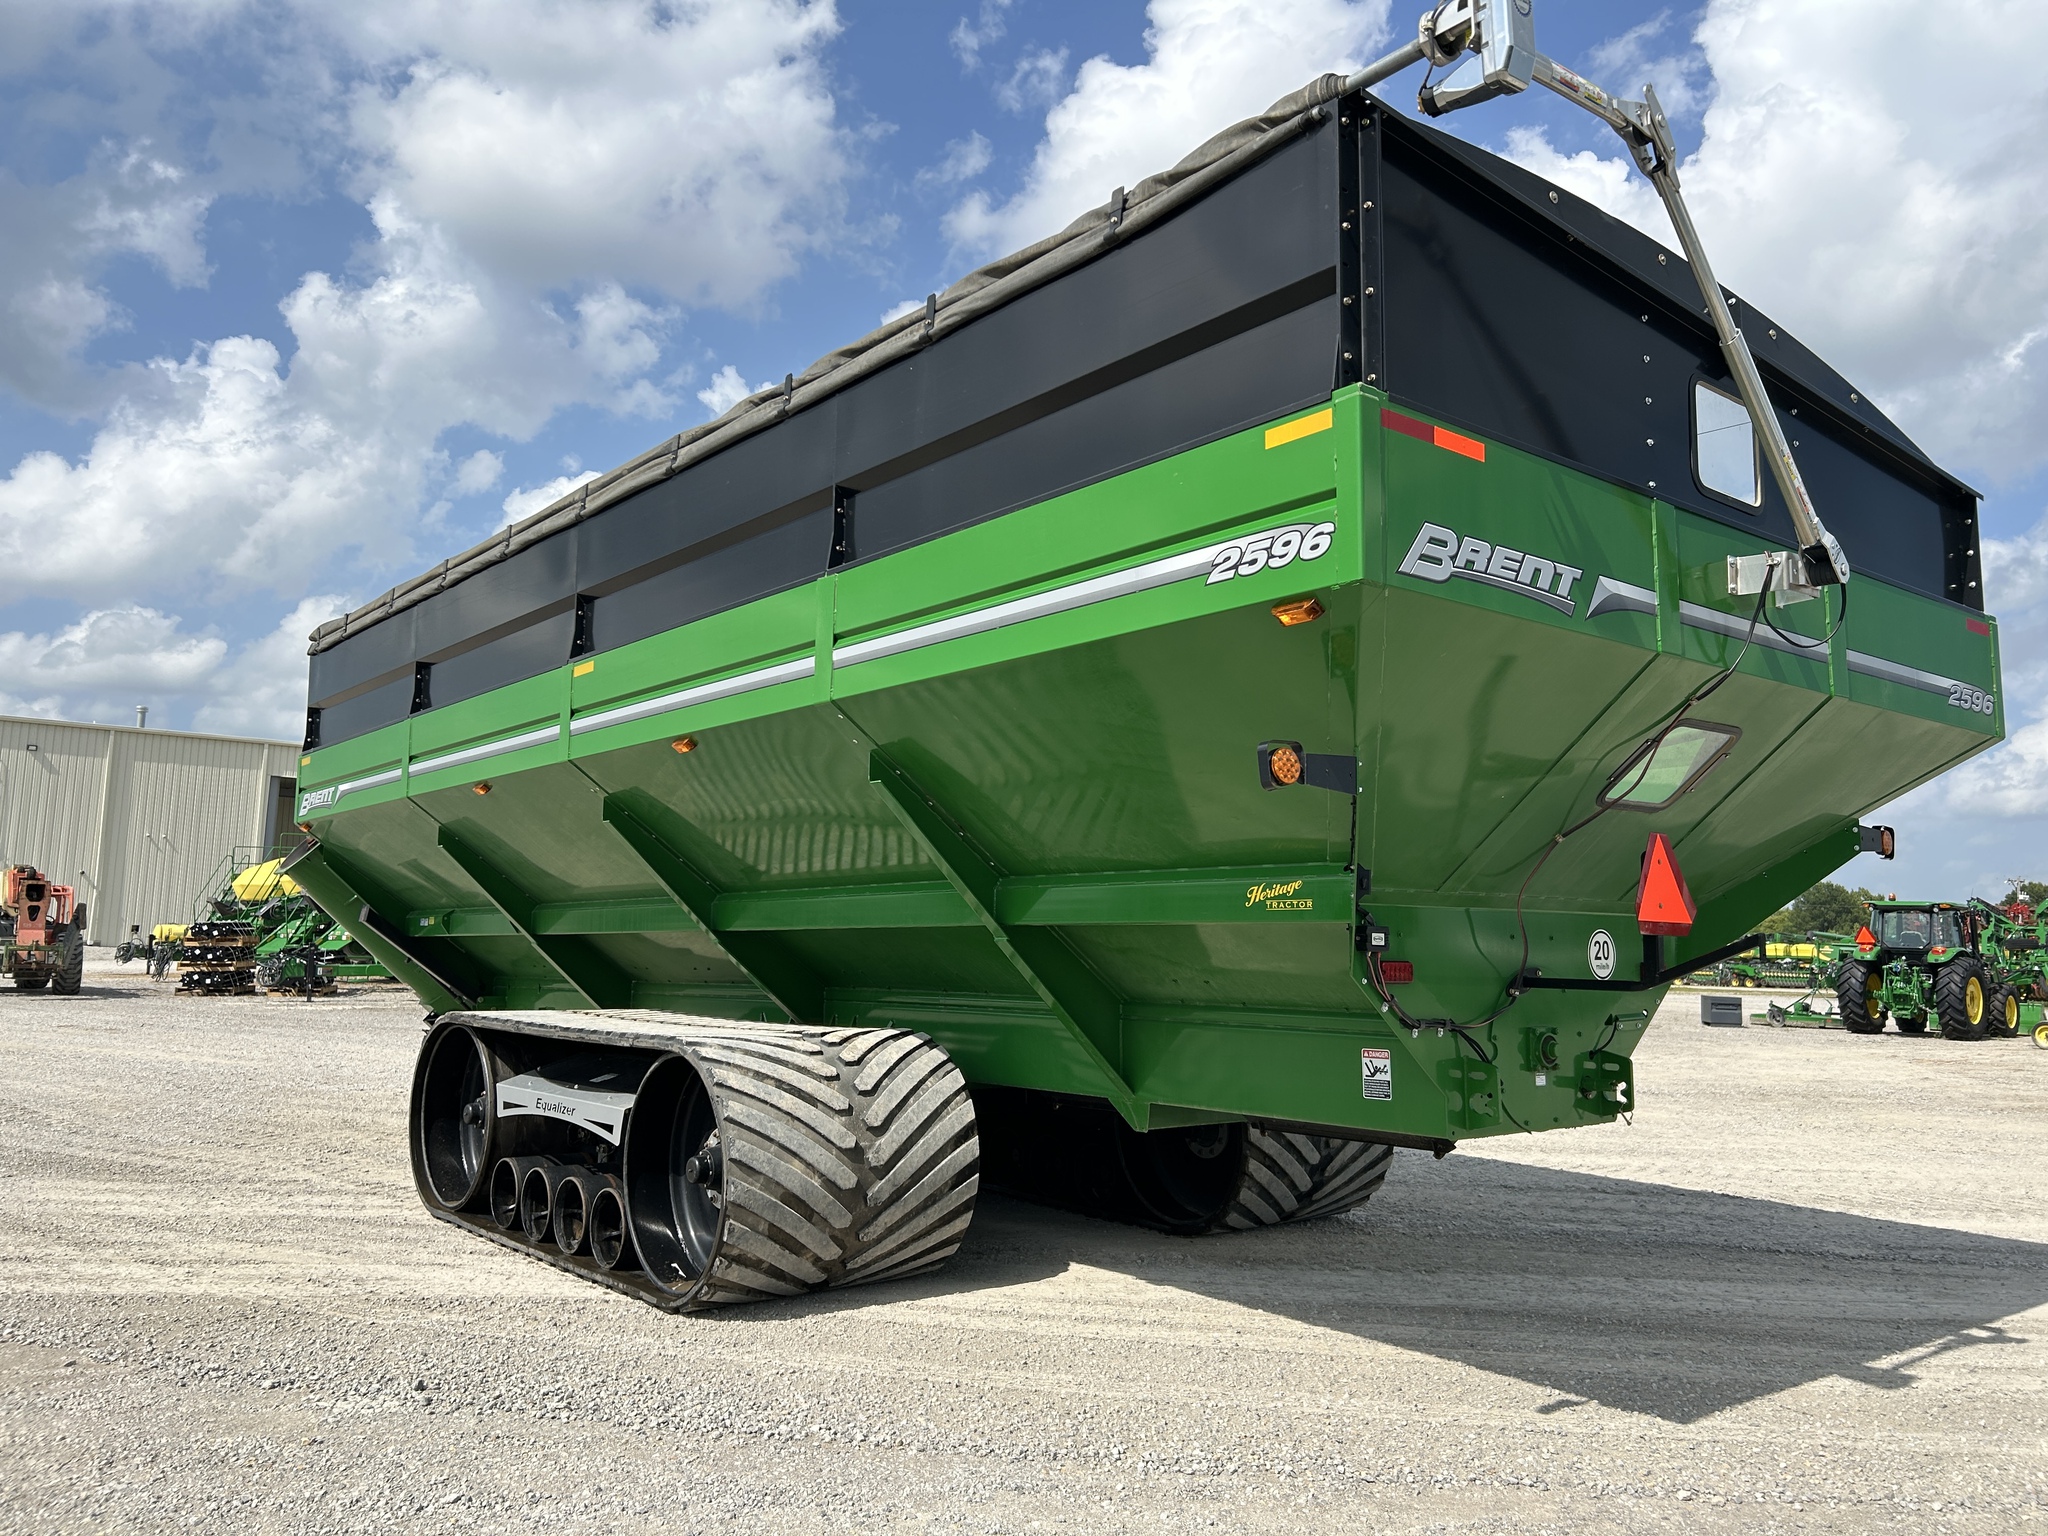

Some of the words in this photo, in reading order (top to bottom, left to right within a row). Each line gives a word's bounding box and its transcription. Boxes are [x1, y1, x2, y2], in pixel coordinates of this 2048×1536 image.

[1205, 521, 1336, 586] 2596
[1395, 520, 1583, 604] BRENT
[1947, 684, 1995, 716] 2596
[1245, 880, 1303, 907] Heritage
[1265, 900, 1313, 909] TRACTOR
[1594, 940, 1609, 960] 20
[1368, 1050, 1389, 1059] DANGER
[535, 1097, 576, 1117] Equalizer
